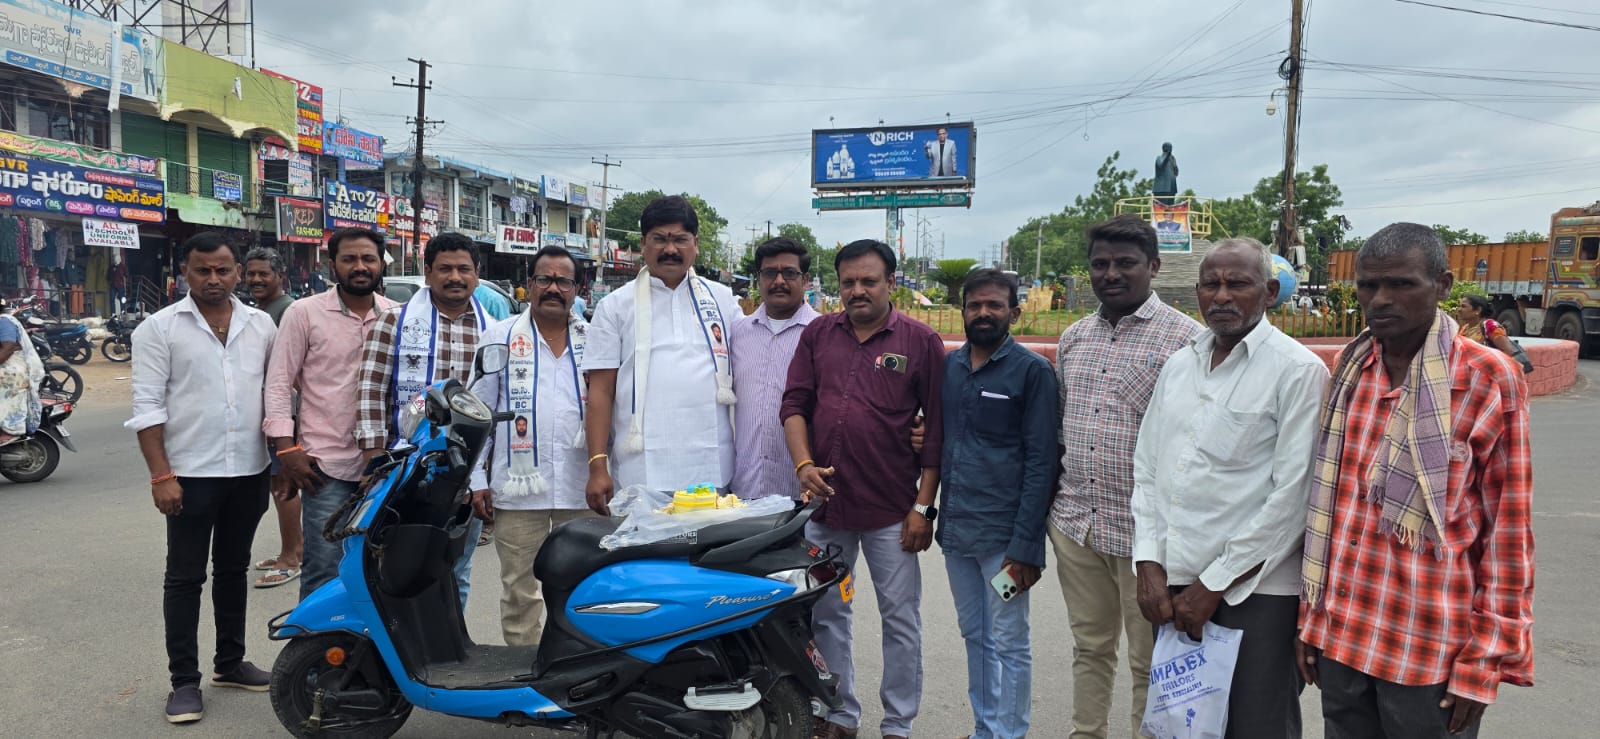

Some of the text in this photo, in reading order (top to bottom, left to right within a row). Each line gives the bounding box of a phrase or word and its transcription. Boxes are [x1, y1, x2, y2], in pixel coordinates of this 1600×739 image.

[886, 131, 913, 143] RICH
[336, 184, 350, 203] A
[366, 190, 378, 208] Z
[293, 207, 315, 226] RED
[103, 222, 120, 230] ALL
[90, 232, 133, 241] UNIFORMS
[95, 228, 129, 236] SCHOOL
[296, 226, 323, 238] FASHIONS
[88, 238, 136, 247] AVAILABLE
[515, 401, 527, 409] BC
[1161, 673, 1196, 692] TAILORS
